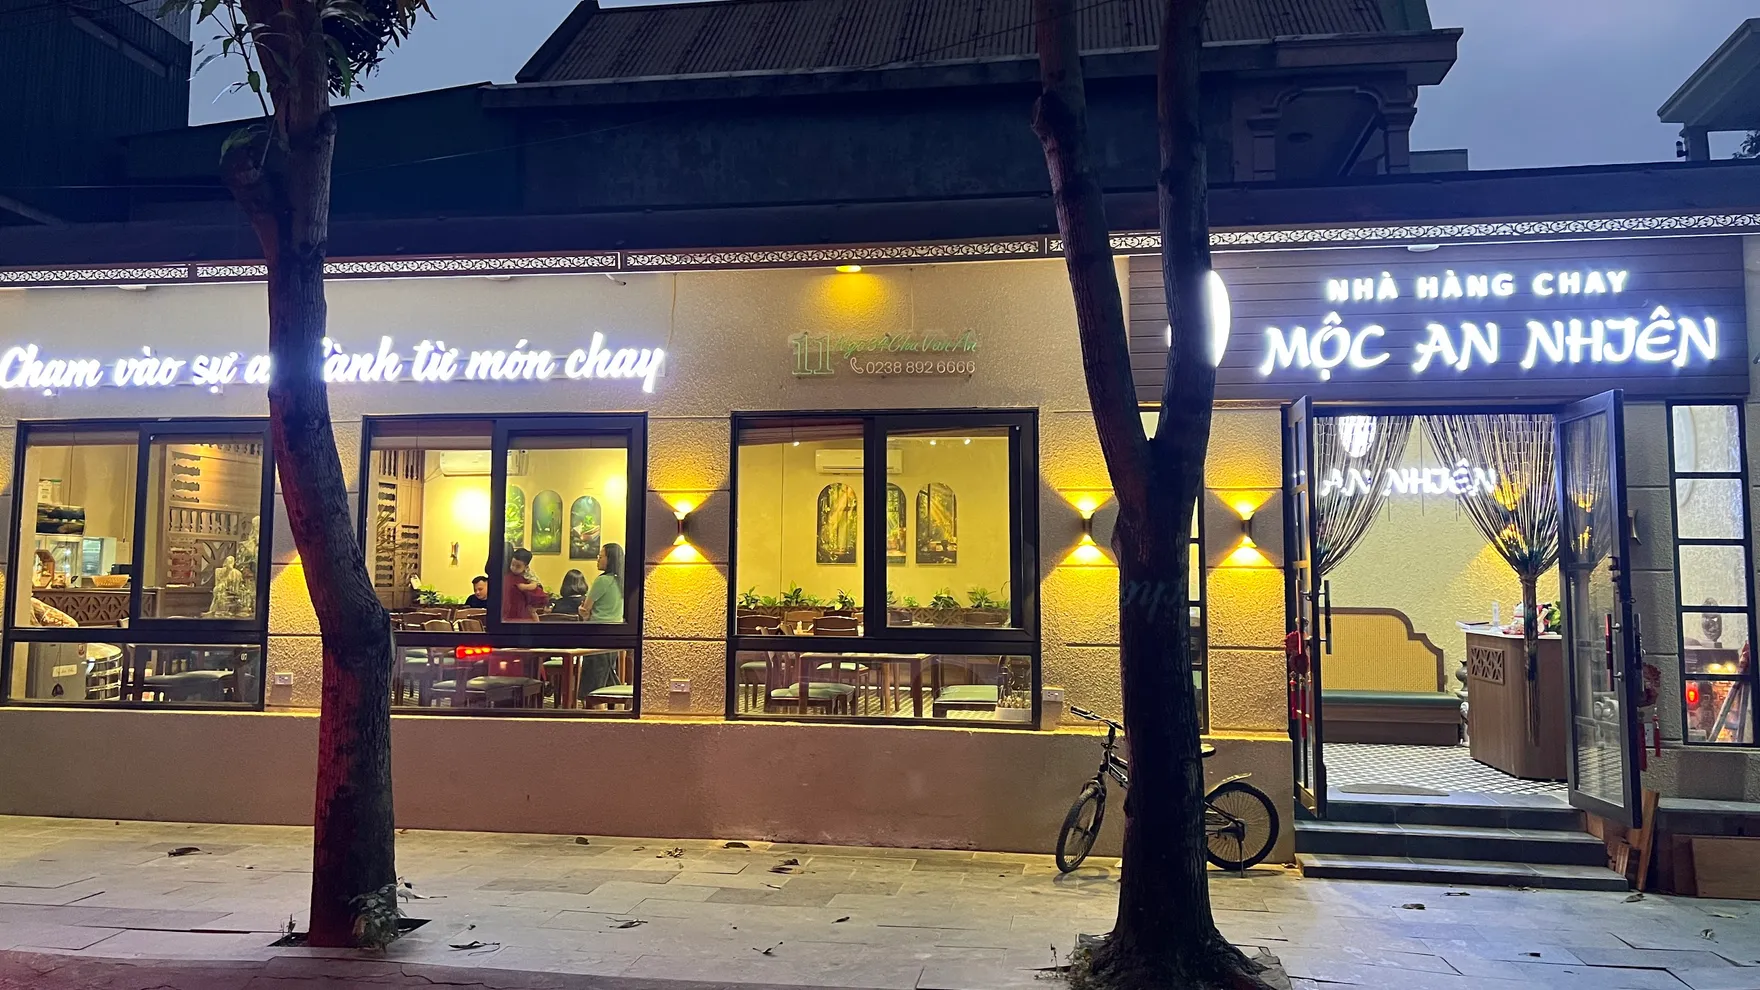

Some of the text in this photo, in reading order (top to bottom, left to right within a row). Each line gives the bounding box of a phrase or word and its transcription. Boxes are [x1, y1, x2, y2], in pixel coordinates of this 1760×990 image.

[1327, 269, 1627, 301] NHÀ HÀNG CHAY
[0, 343, 103, 396] Chạm
[112, 346, 187, 387] vào
[191, 351, 240, 394] sự
[322, 335, 403, 383] ành
[412, 339, 459, 382] từ
[465, 338, 555, 381] món
[564, 331, 665, 394] chay
[791, 333, 835, 375] 11
[866, 360, 976, 374] 0238 892 6666
[1259, 311, 1390, 381] MỘC
[1412, 322, 1499, 373] AN
